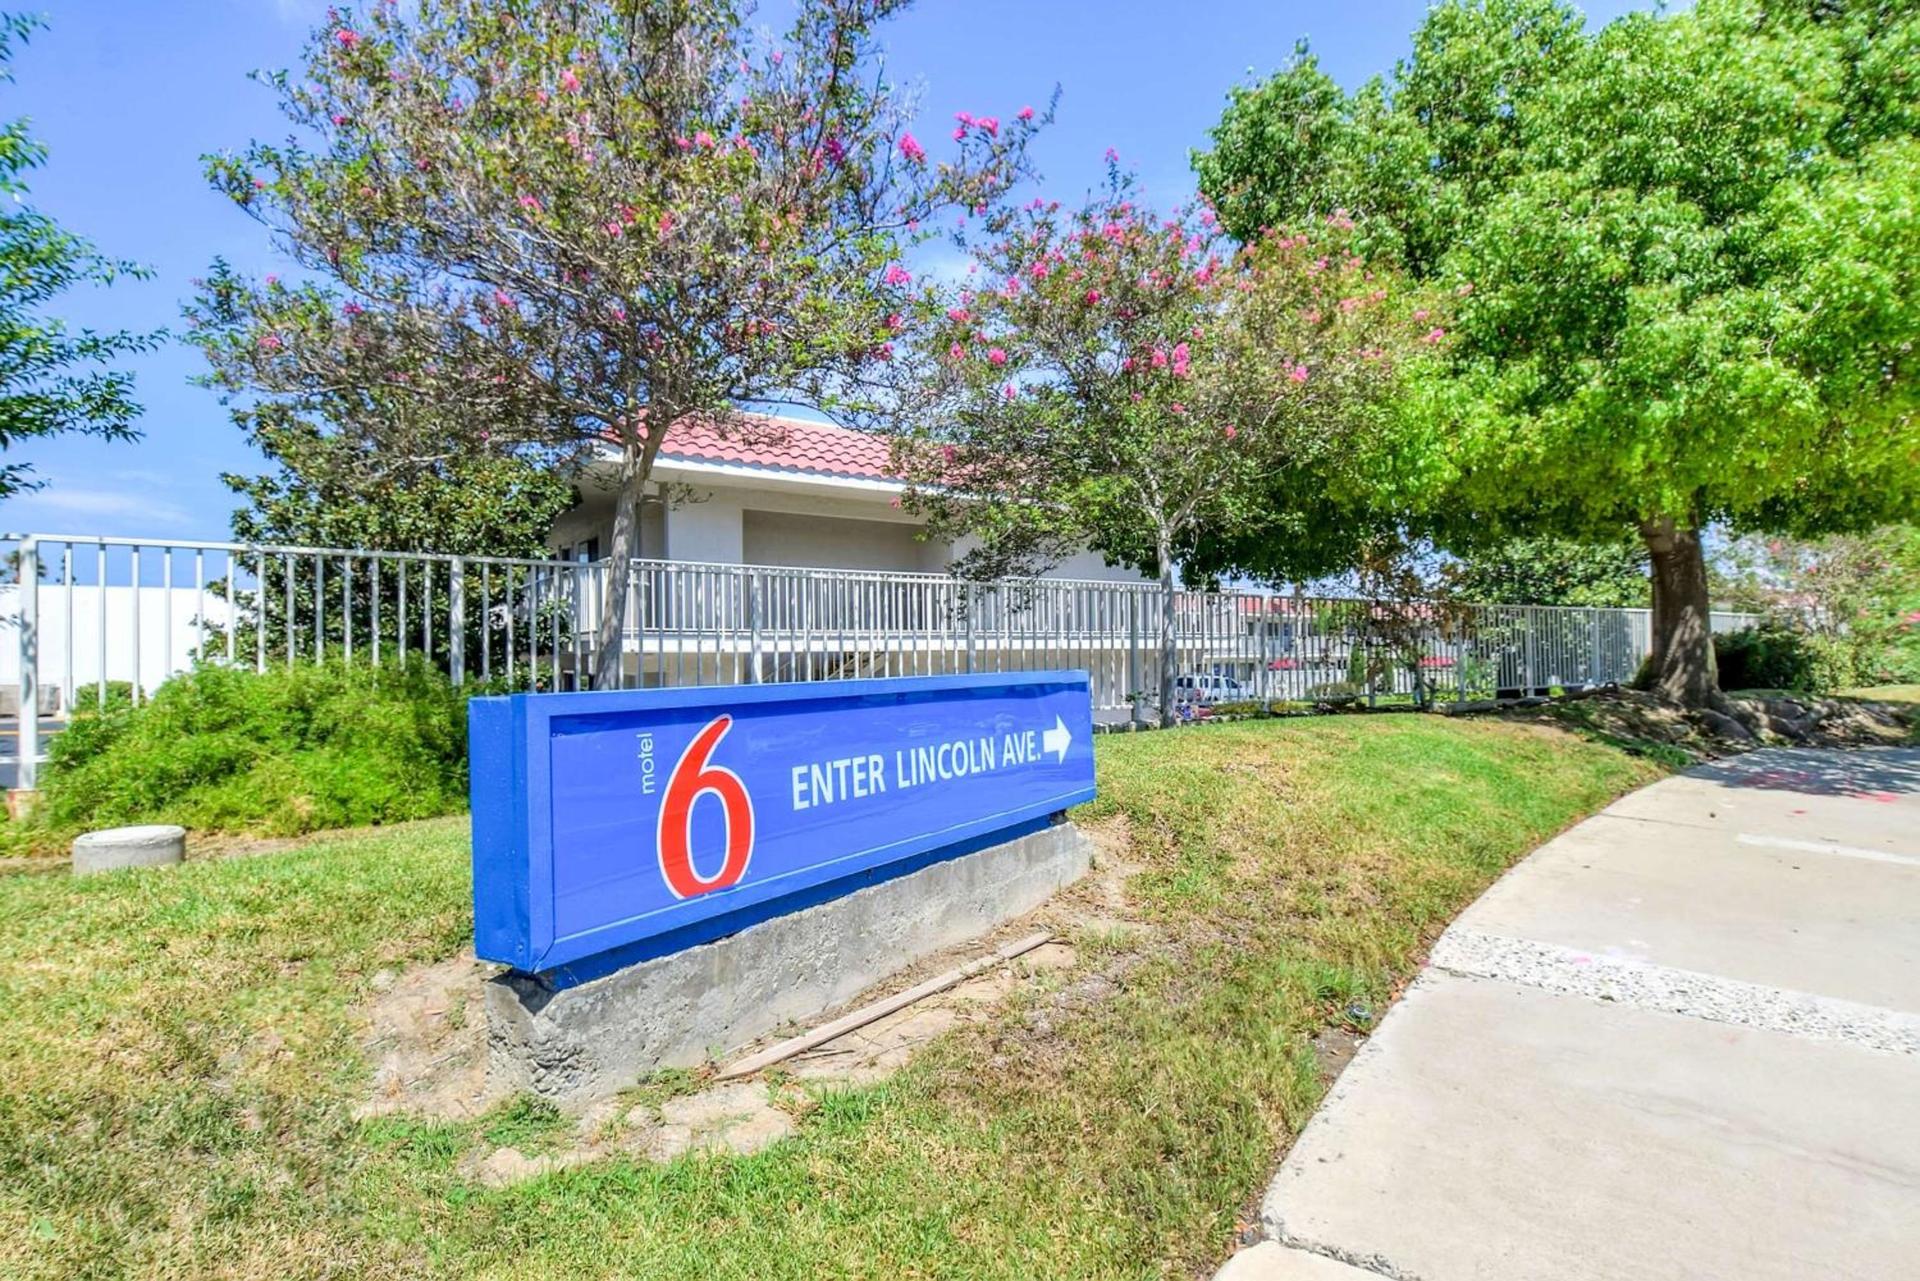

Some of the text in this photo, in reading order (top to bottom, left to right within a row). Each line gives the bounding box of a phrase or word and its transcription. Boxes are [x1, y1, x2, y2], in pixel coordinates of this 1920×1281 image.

[636, 732, 655, 794] motel
[791, 729, 1041, 811] ENTER LINCOLN AVE.
[656, 713, 756, 900] 6
